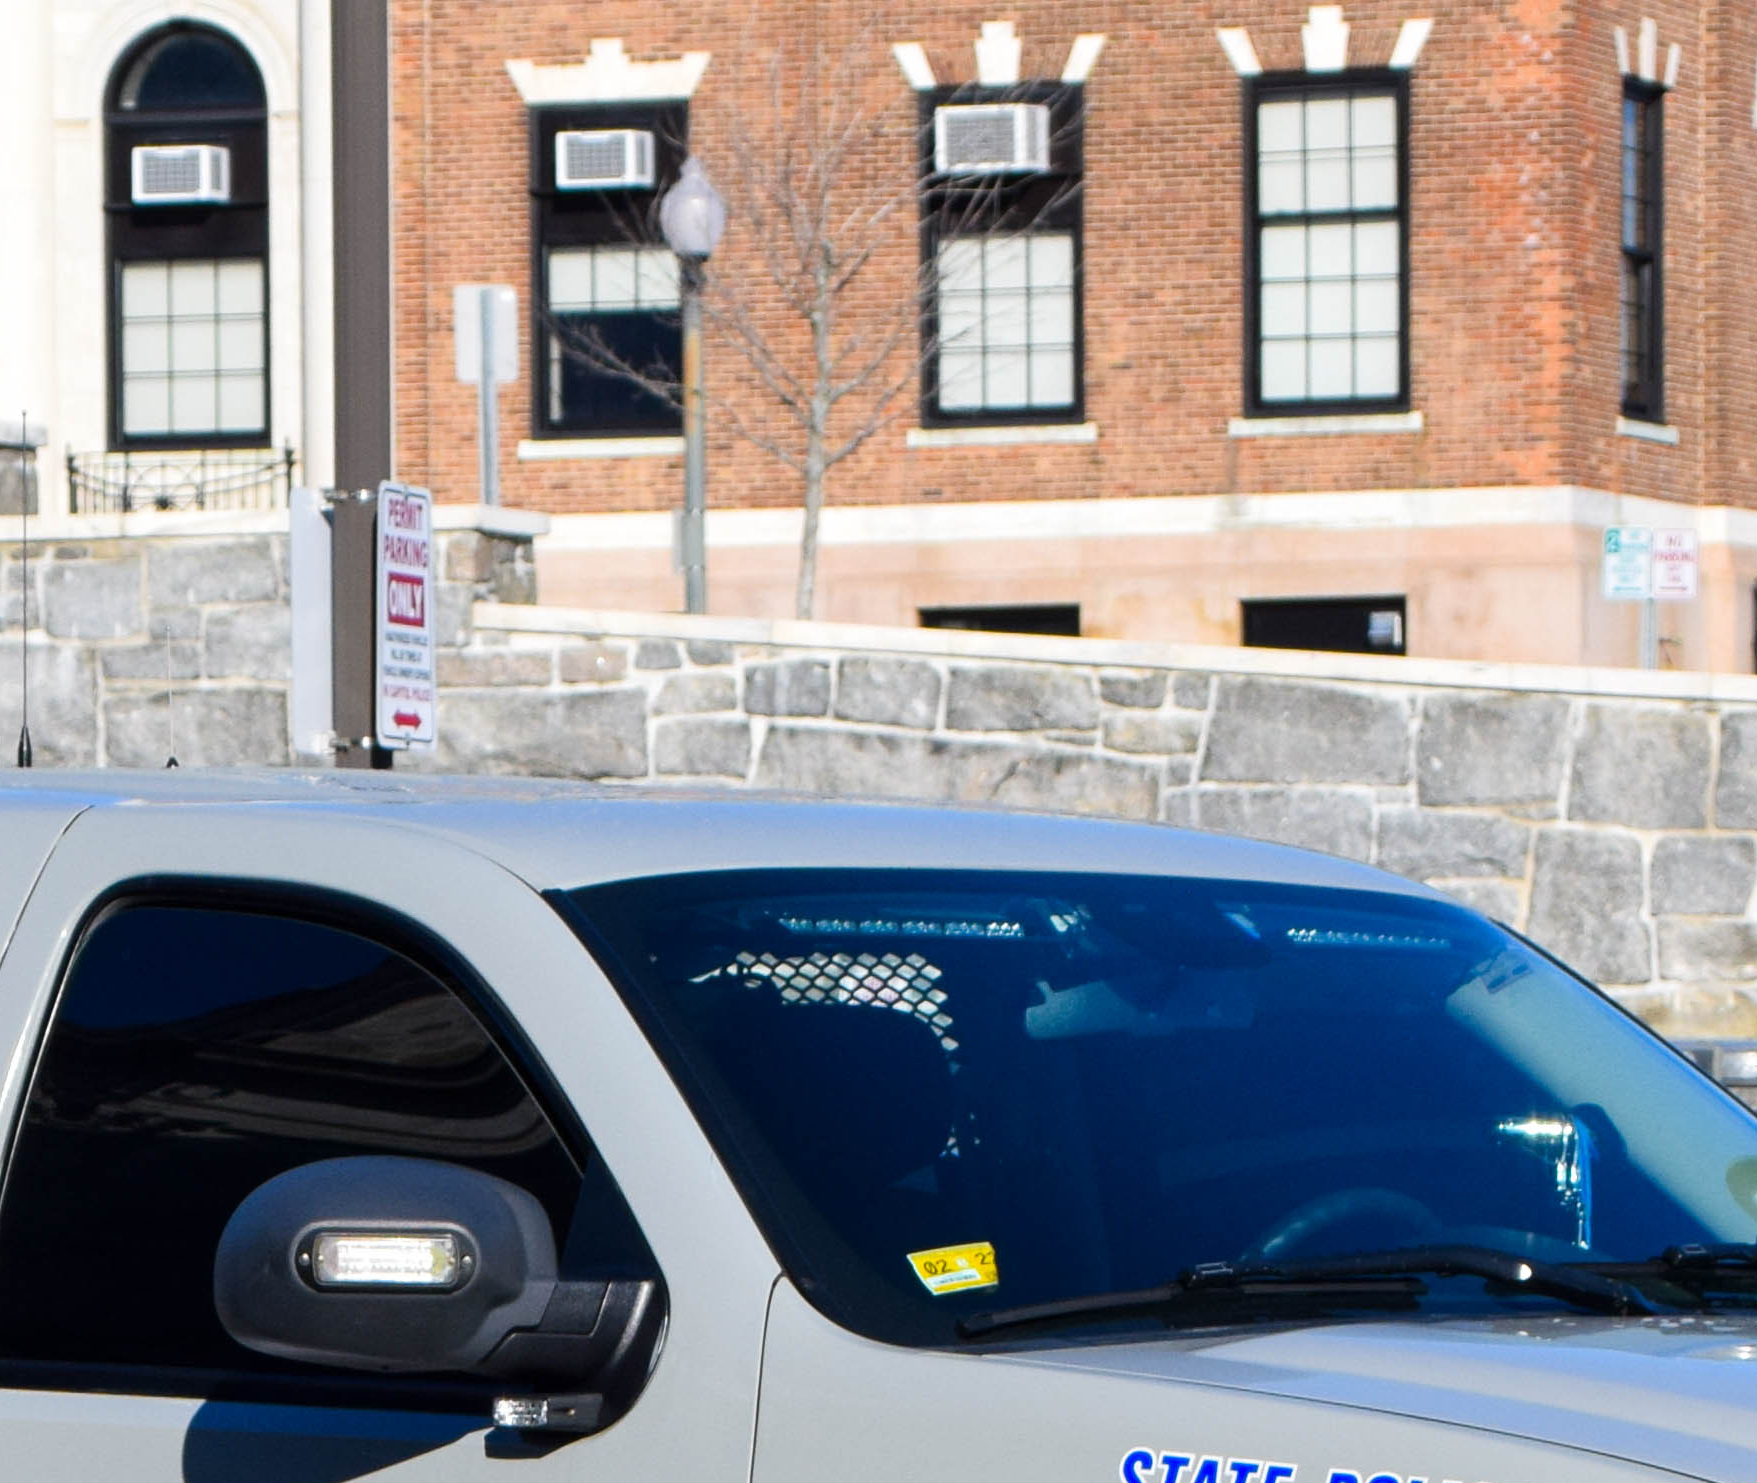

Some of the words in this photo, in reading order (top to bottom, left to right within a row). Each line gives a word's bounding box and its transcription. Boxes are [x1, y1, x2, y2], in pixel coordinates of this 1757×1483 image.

[388, 499, 423, 531] PERMIT
[384, 535, 428, 569] PARKING
[388, 578, 424, 620] ONLY
